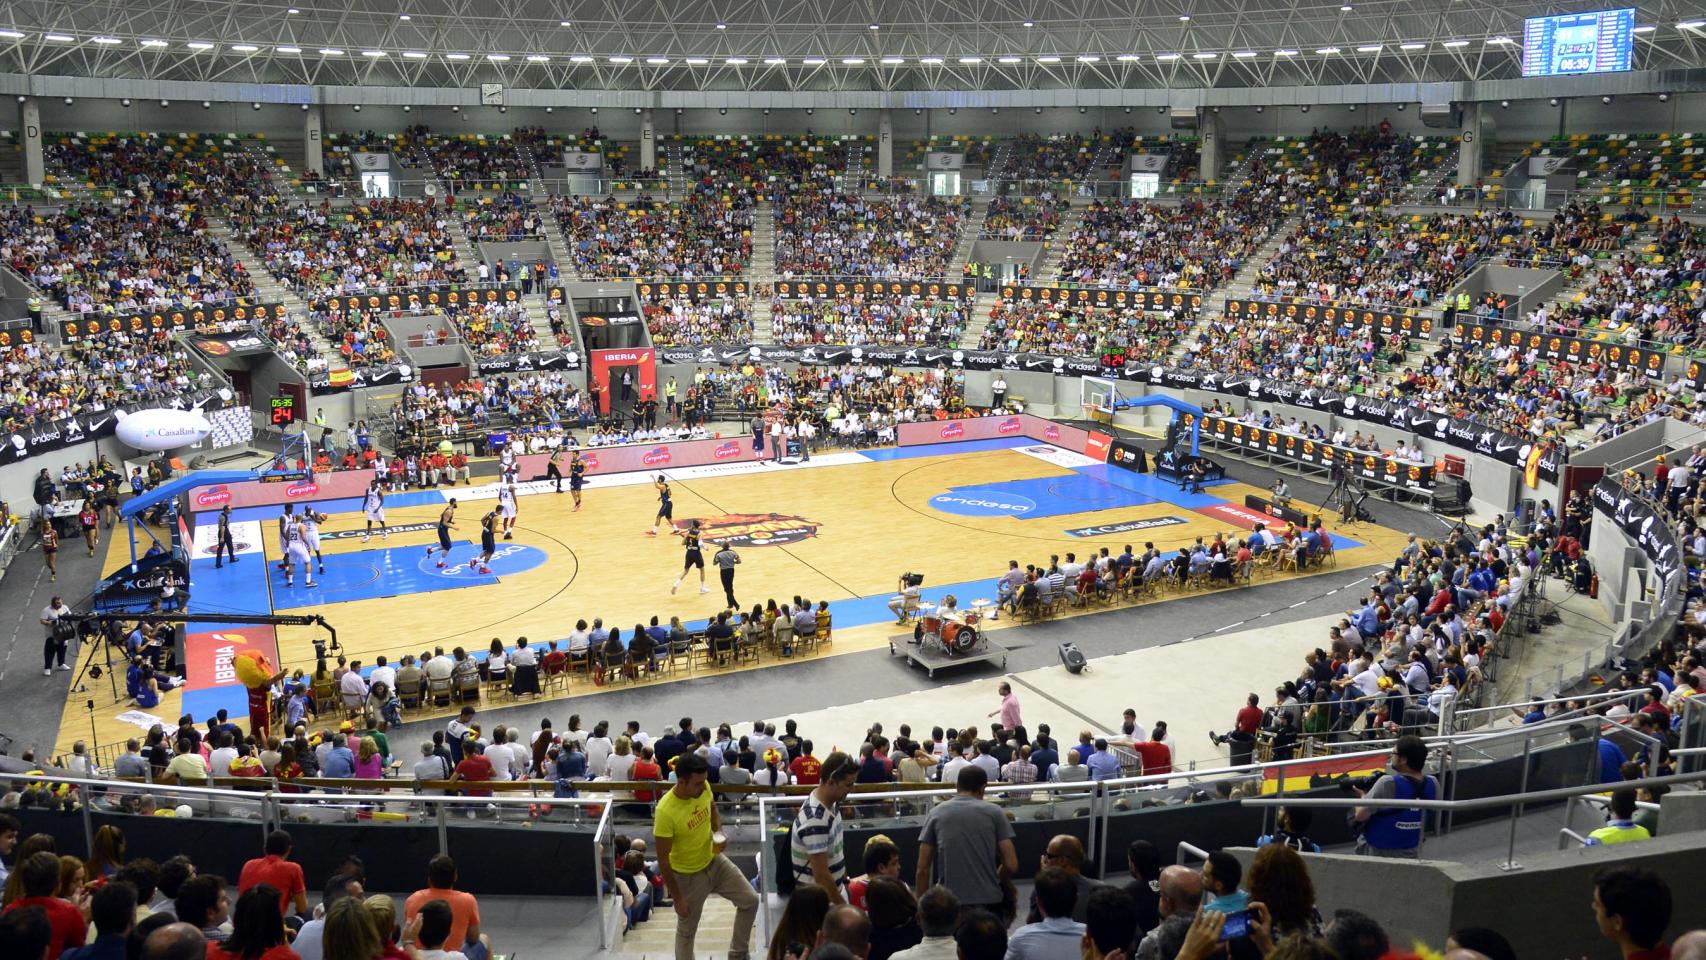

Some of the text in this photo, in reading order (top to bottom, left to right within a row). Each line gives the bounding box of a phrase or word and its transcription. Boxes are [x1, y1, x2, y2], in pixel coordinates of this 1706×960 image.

[27, 125, 38, 138] D
[310, 129, 319, 140] E
[643, 129, 651, 139] E
[882, 133, 889, 143] F
[1206, 133, 1212, 143] F
[1462, 131, 1473, 143] G
[227, 337, 261, 348] FEB
[605, 353, 638, 361] IBERIA
[664, 351, 694, 359] endesa
[766, 350, 796, 358] endesa
[868, 351, 897, 360] endesa
[968, 355, 998, 364] endesa
[1111, 354, 1124, 367] 24
[480, 361, 510, 369] endesa
[1068, 362, 1097, 372] endesa
[1167, 373, 1196, 383] endesa
[1264, 387, 1292, 398] endesa
[271, 399, 293, 407] 05:35
[272, 408, 292, 423] 24
[1359, 404, 1387, 417] endesa
[158, 427, 195, 437] CaixaBank
[1448, 427, 1474, 441] endesa
[31, 431, 60, 445] endesa
[936, 495, 1030, 512] endesa
[1099, 517, 1180, 533] CaixaBank
[215, 645, 236, 683] IBERIA
